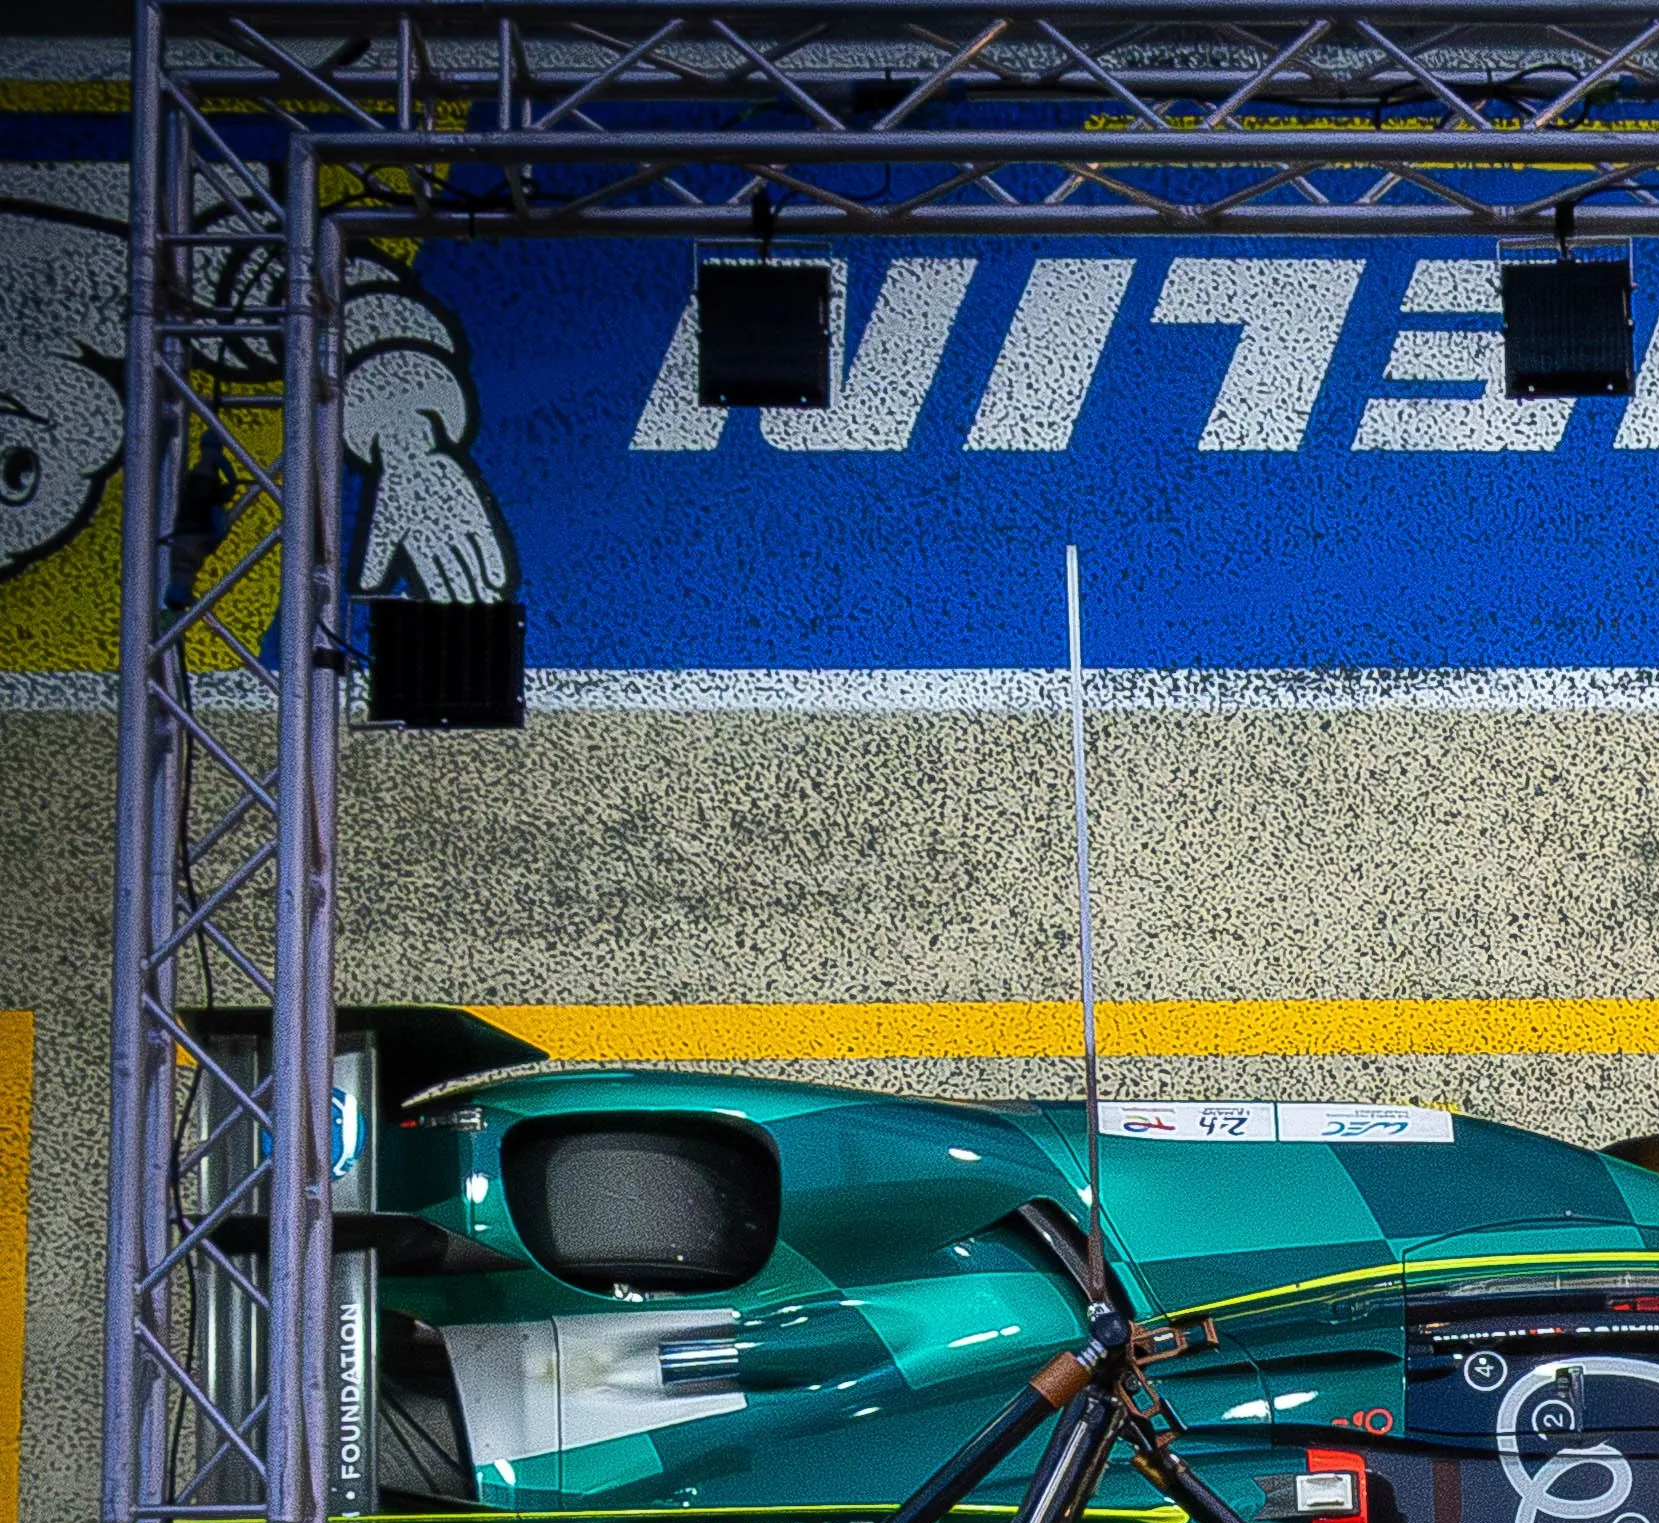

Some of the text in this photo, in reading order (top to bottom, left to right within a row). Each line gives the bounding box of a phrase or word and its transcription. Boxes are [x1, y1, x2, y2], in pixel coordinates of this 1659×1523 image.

[1474, 1358, 1495, 1378] 4
[341, 1303, 362, 1479] FOUNDATION
[1543, 1413, 1563, 1427] 2
